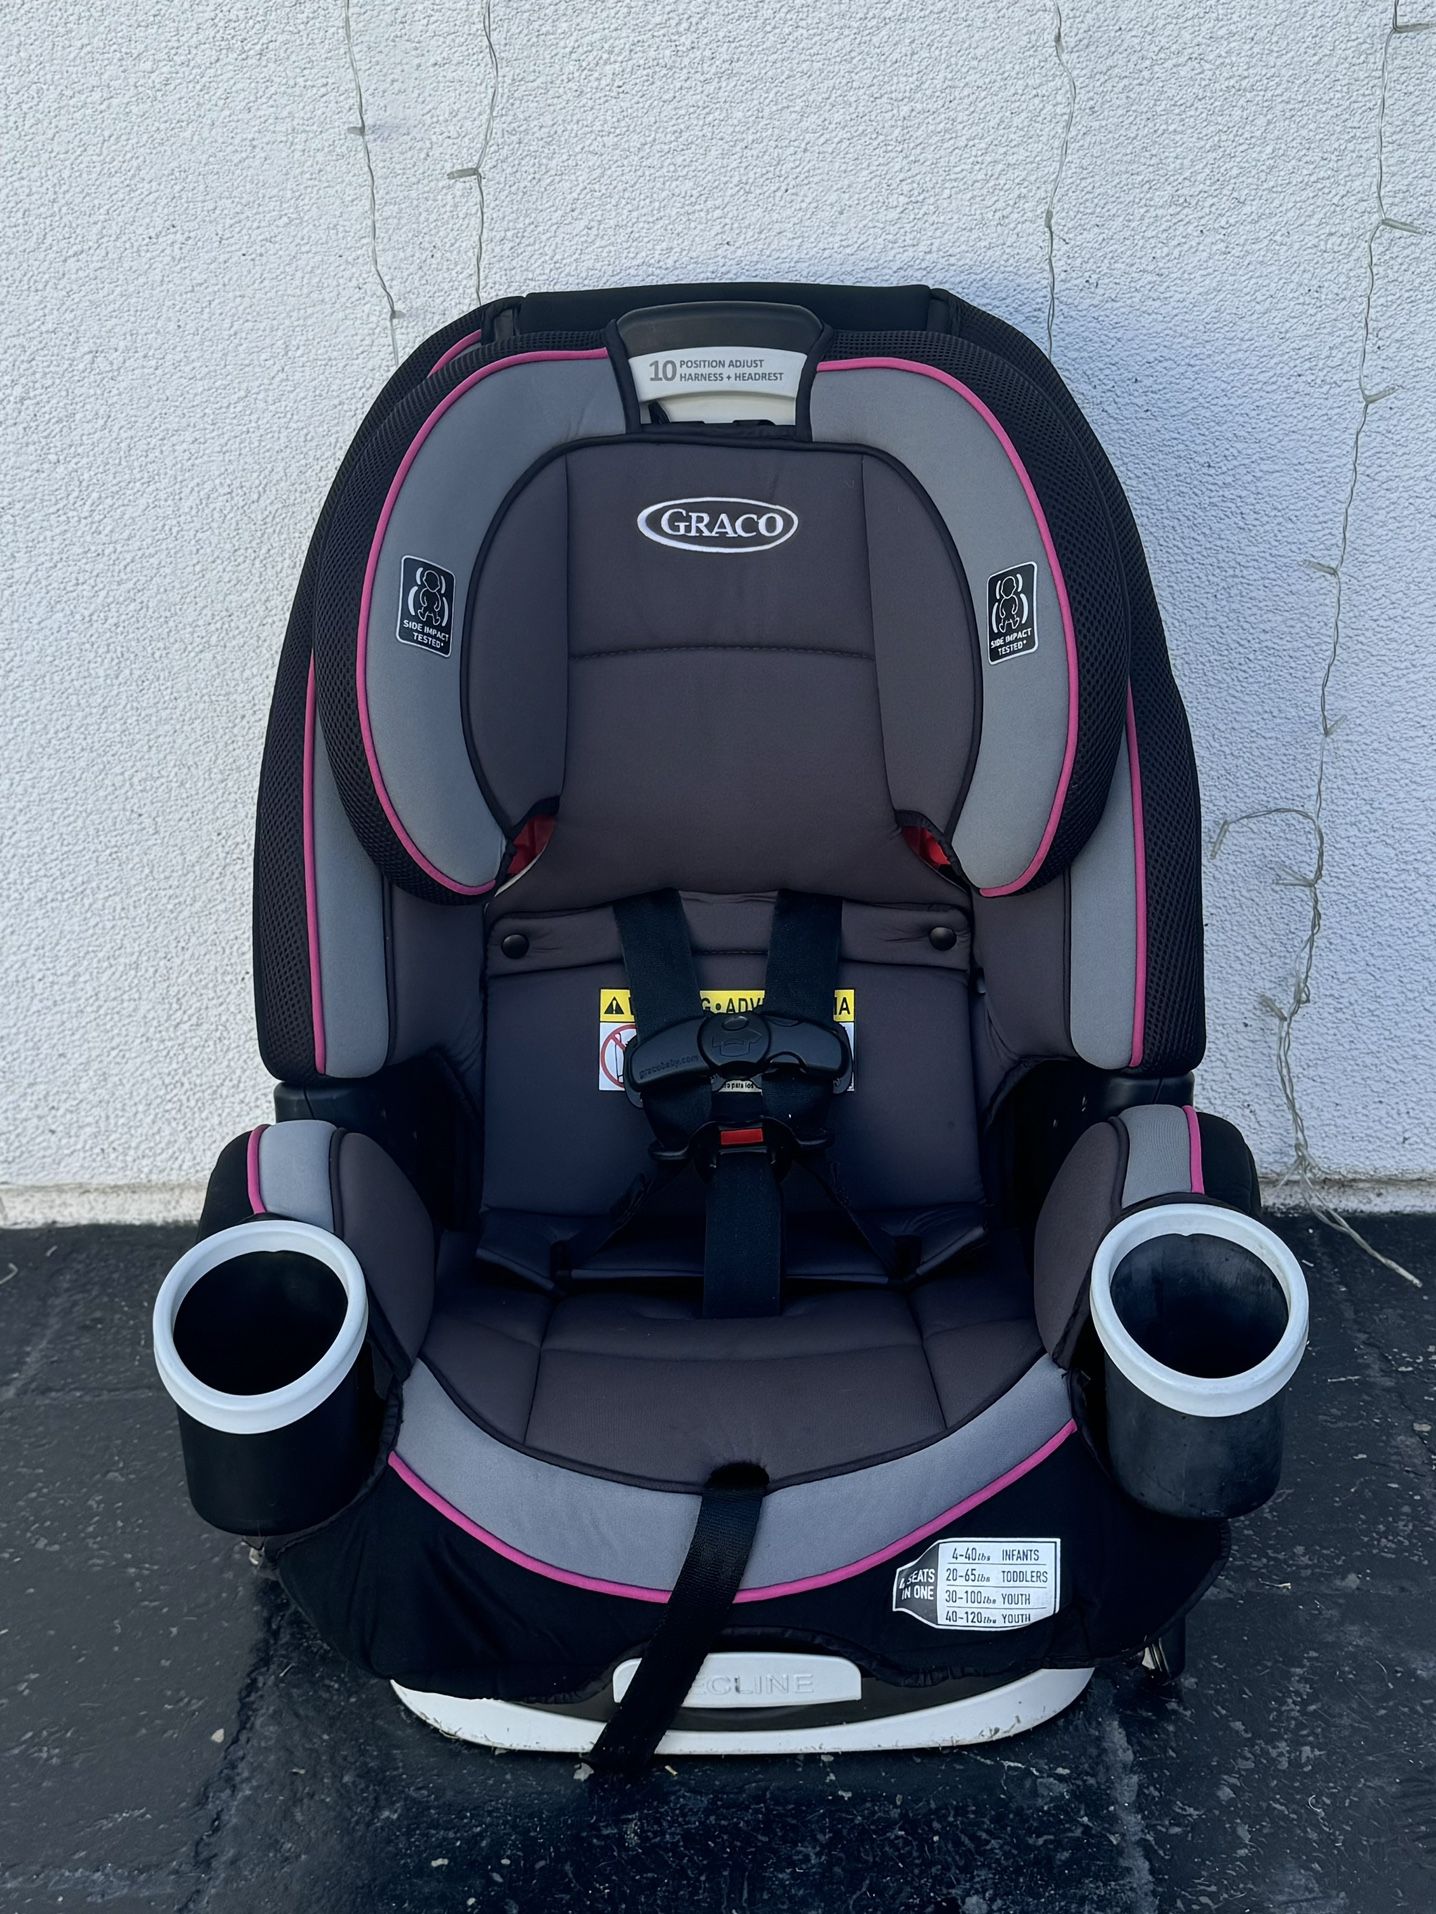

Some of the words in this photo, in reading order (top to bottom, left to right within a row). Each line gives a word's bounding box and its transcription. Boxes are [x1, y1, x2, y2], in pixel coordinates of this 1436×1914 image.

[679, 359, 726, 369] POSITION
[728, 359, 764, 369] ADJUST
[648, 360, 677, 382] 10
[679, 372, 724, 382] HARNESS
[734, 372, 784, 382] HEADREST
[660, 508, 784, 538] GRACO
[403, 619, 423, 632] SIDE
[424, 626, 449, 642] IMPACT
[990, 637, 1005, 649] SIDE
[1005, 628, 1032, 643] IMPACT
[1001, 1549, 1040, 1562] INFANTS
[1001, 1570, 1048, 1583] TODDLERS
[901, 1586, 911, 1600] IN
[913, 1585, 935, 1600] ONE
[1001, 1593, 1031, 1605] YOUTH
[1001, 1613, 1031, 1624] YOUTH
